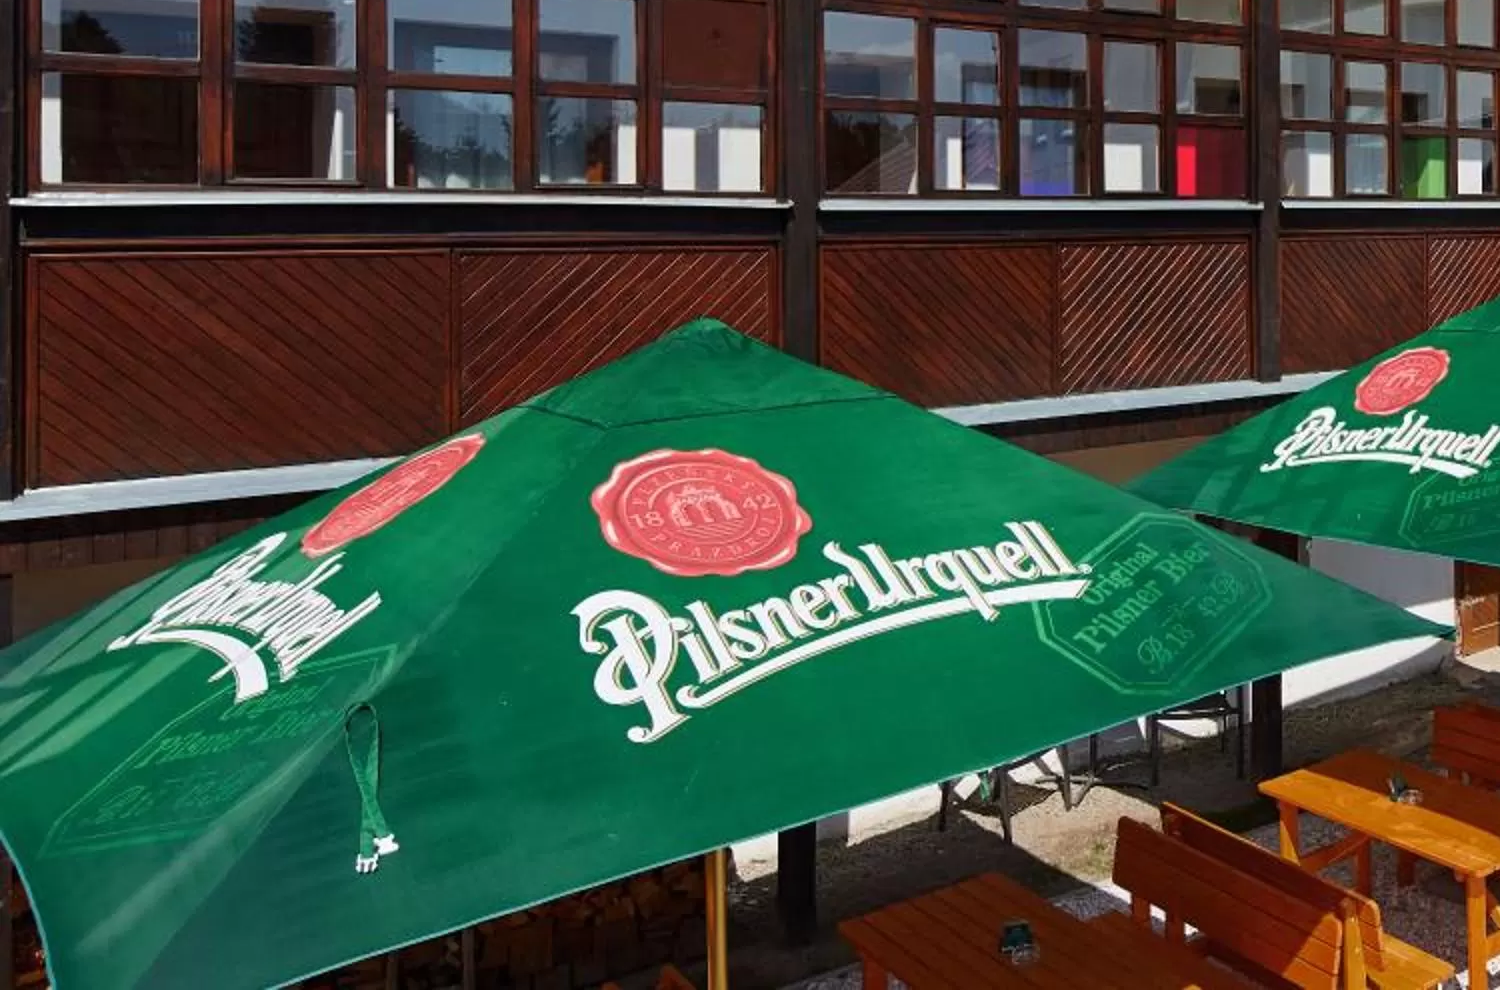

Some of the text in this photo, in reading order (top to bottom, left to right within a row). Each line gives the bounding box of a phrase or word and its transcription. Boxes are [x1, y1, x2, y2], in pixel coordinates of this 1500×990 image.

[1260, 406, 1394, 473] Pilsner
[629, 511, 664, 529] 18
[570, 520, 1092, 743] Pilsner Urquell
[1072, 579, 1164, 655] Pilsner
